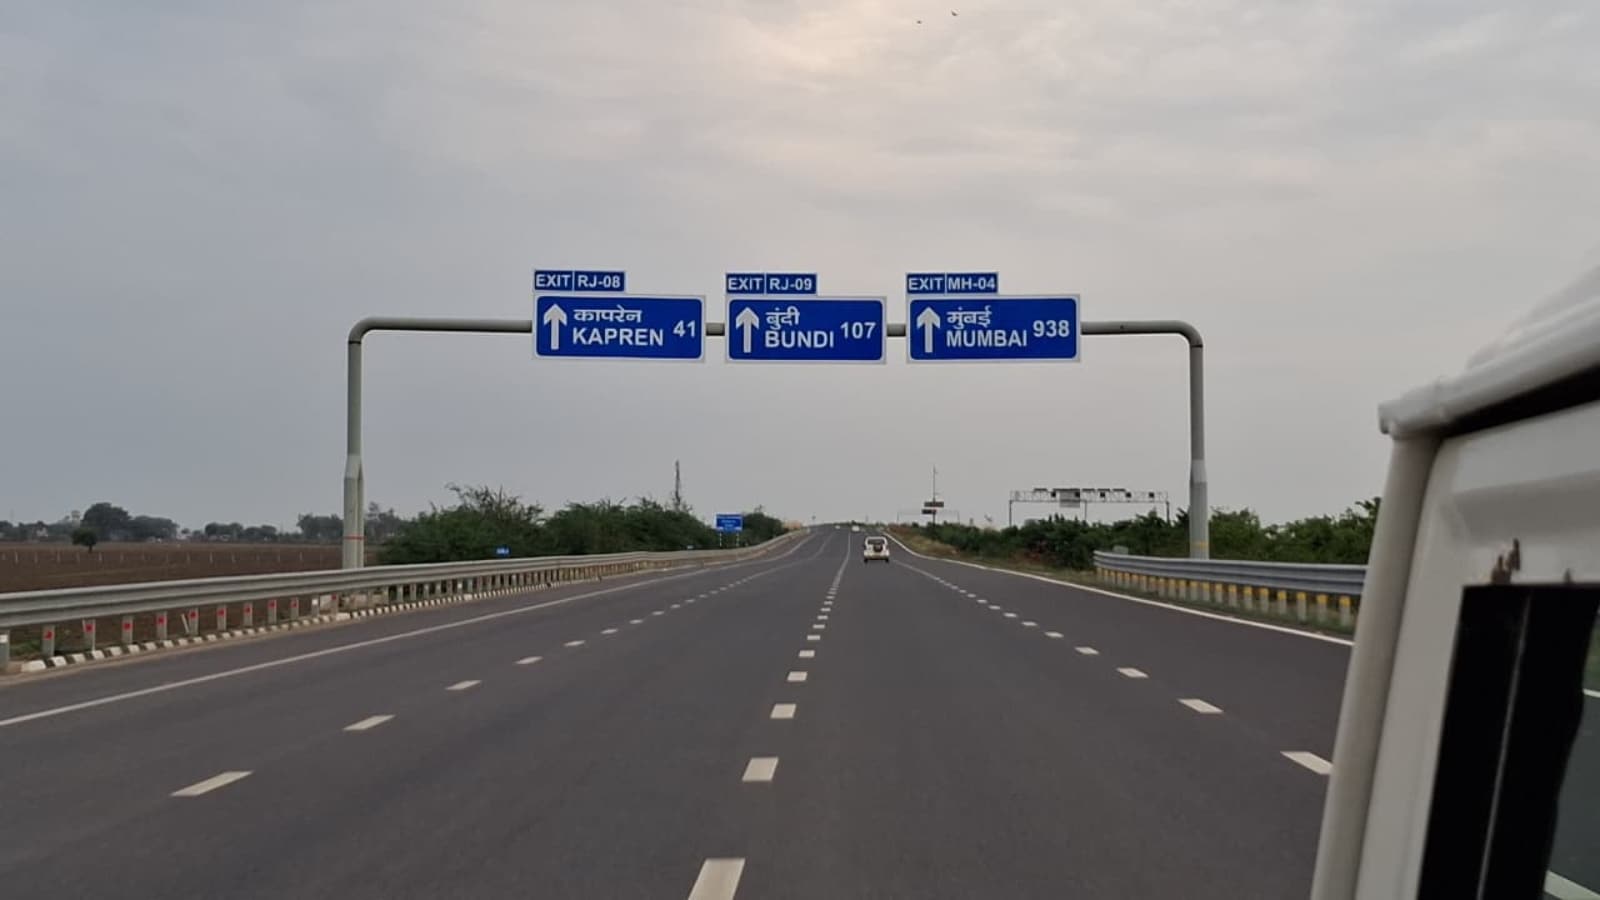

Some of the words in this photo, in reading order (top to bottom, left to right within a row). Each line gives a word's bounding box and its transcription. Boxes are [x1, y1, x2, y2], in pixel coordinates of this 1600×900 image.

[535, 274, 571, 288] EXIT
[577, 275, 621, 289] RJ-08
[727, 277, 763, 291] EXIT
[769, 278, 813, 291] RJ-09
[908, 277, 944, 291] EXIT
[948, 277, 996, 290] MH-04
[573, 305, 643, 323] कापरेन
[765, 305, 801, 331] बुंदी
[946, 305, 992, 330] मुंबई
[572, 327, 664, 347] KAPREN
[673, 320, 696, 338] 41
[840, 321, 877, 339] 107
[1032, 319, 1071, 338] 938
[764, 330, 835, 348] BUNDI
[945, 329, 1028, 348] MUMBAI
